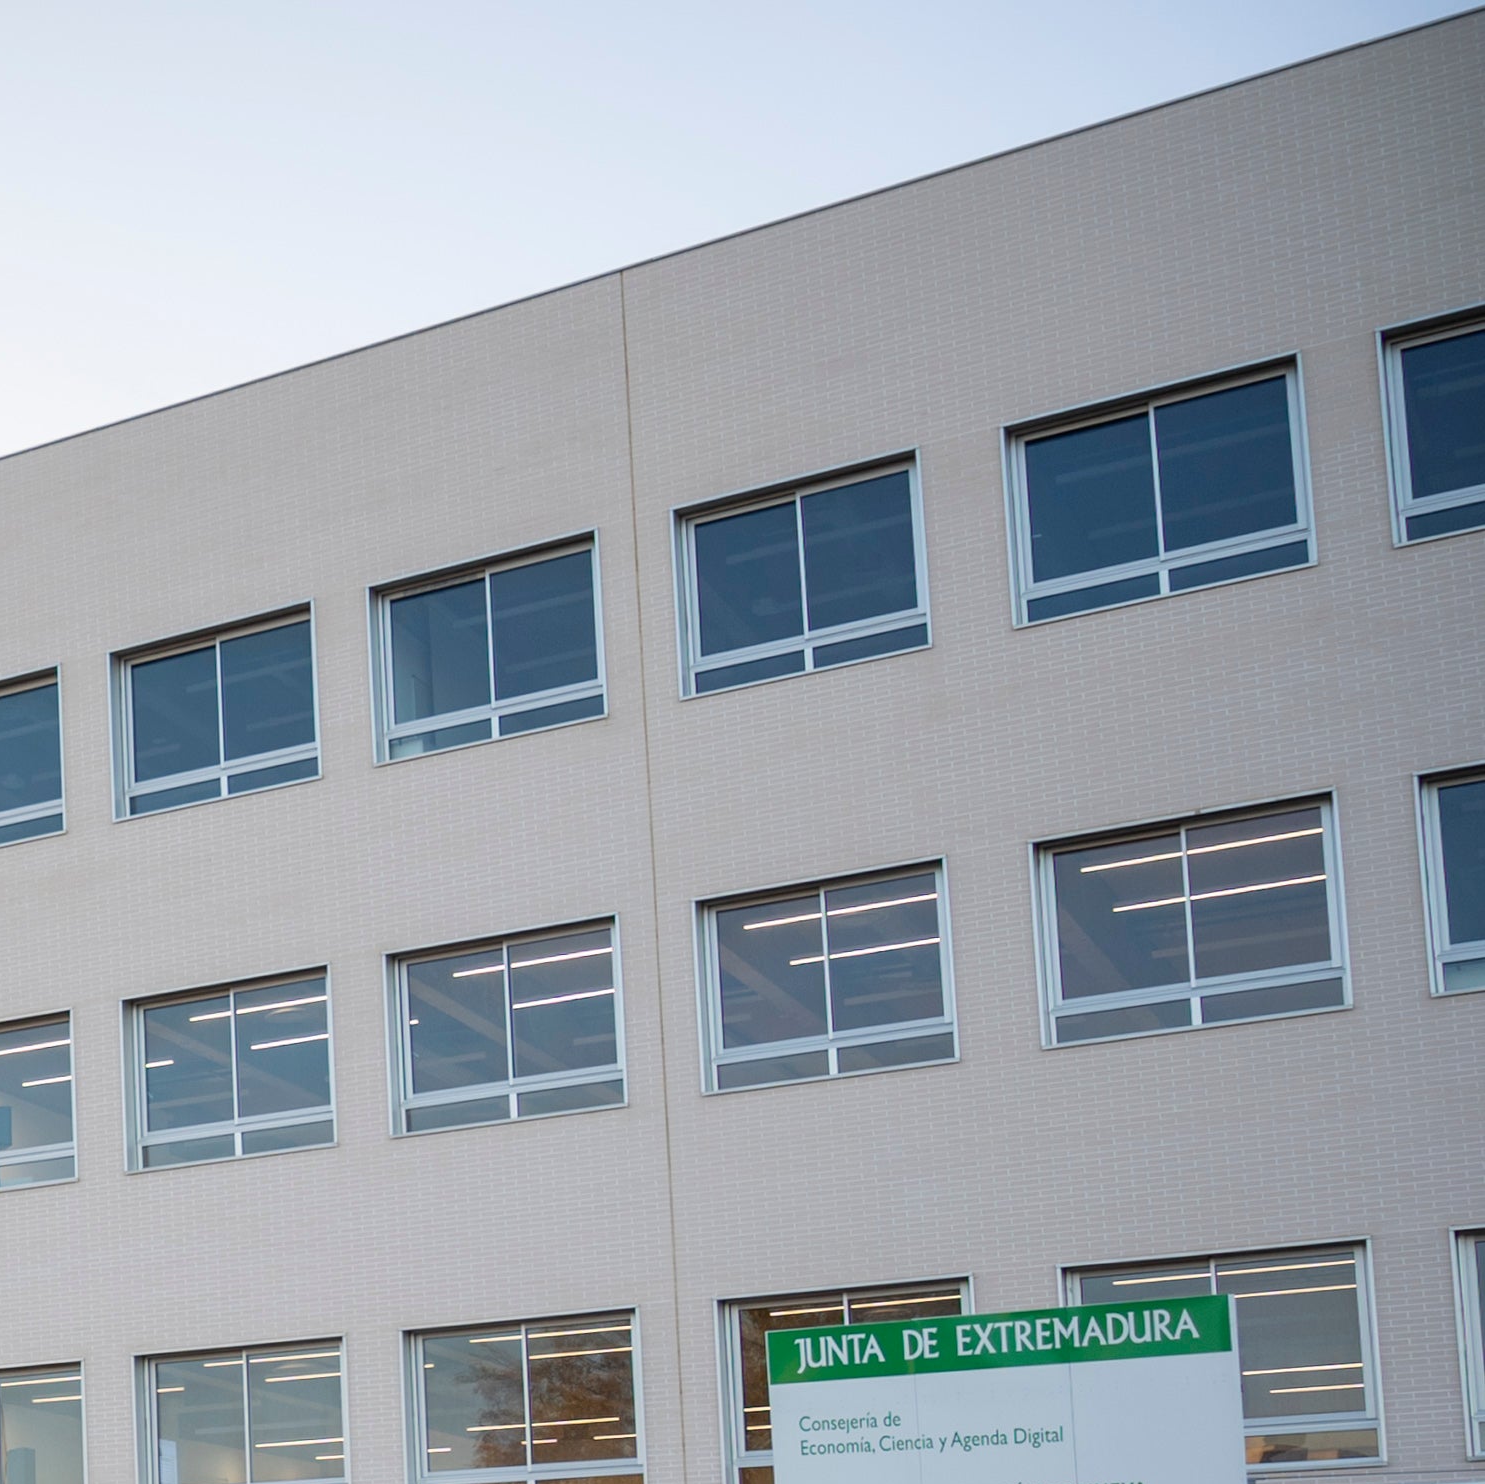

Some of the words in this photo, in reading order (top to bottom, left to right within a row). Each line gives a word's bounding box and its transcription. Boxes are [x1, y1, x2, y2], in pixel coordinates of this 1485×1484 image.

[794, 1333, 885, 1374] JUNTA
[904, 1328, 939, 1361] DE
[956, 1308, 1200, 1357] EXTREMADURA
[798, 1412, 879, 1434] Consejería
[883, 1411, 902, 1429] de
[799, 1435, 876, 1456] Economía,
[879, 1433, 935, 1454] Ciencia
[939, 1436, 947, 1453] y
[951, 1428, 1008, 1452] Agenda
[1013, 1426, 1064, 1449] Digital
